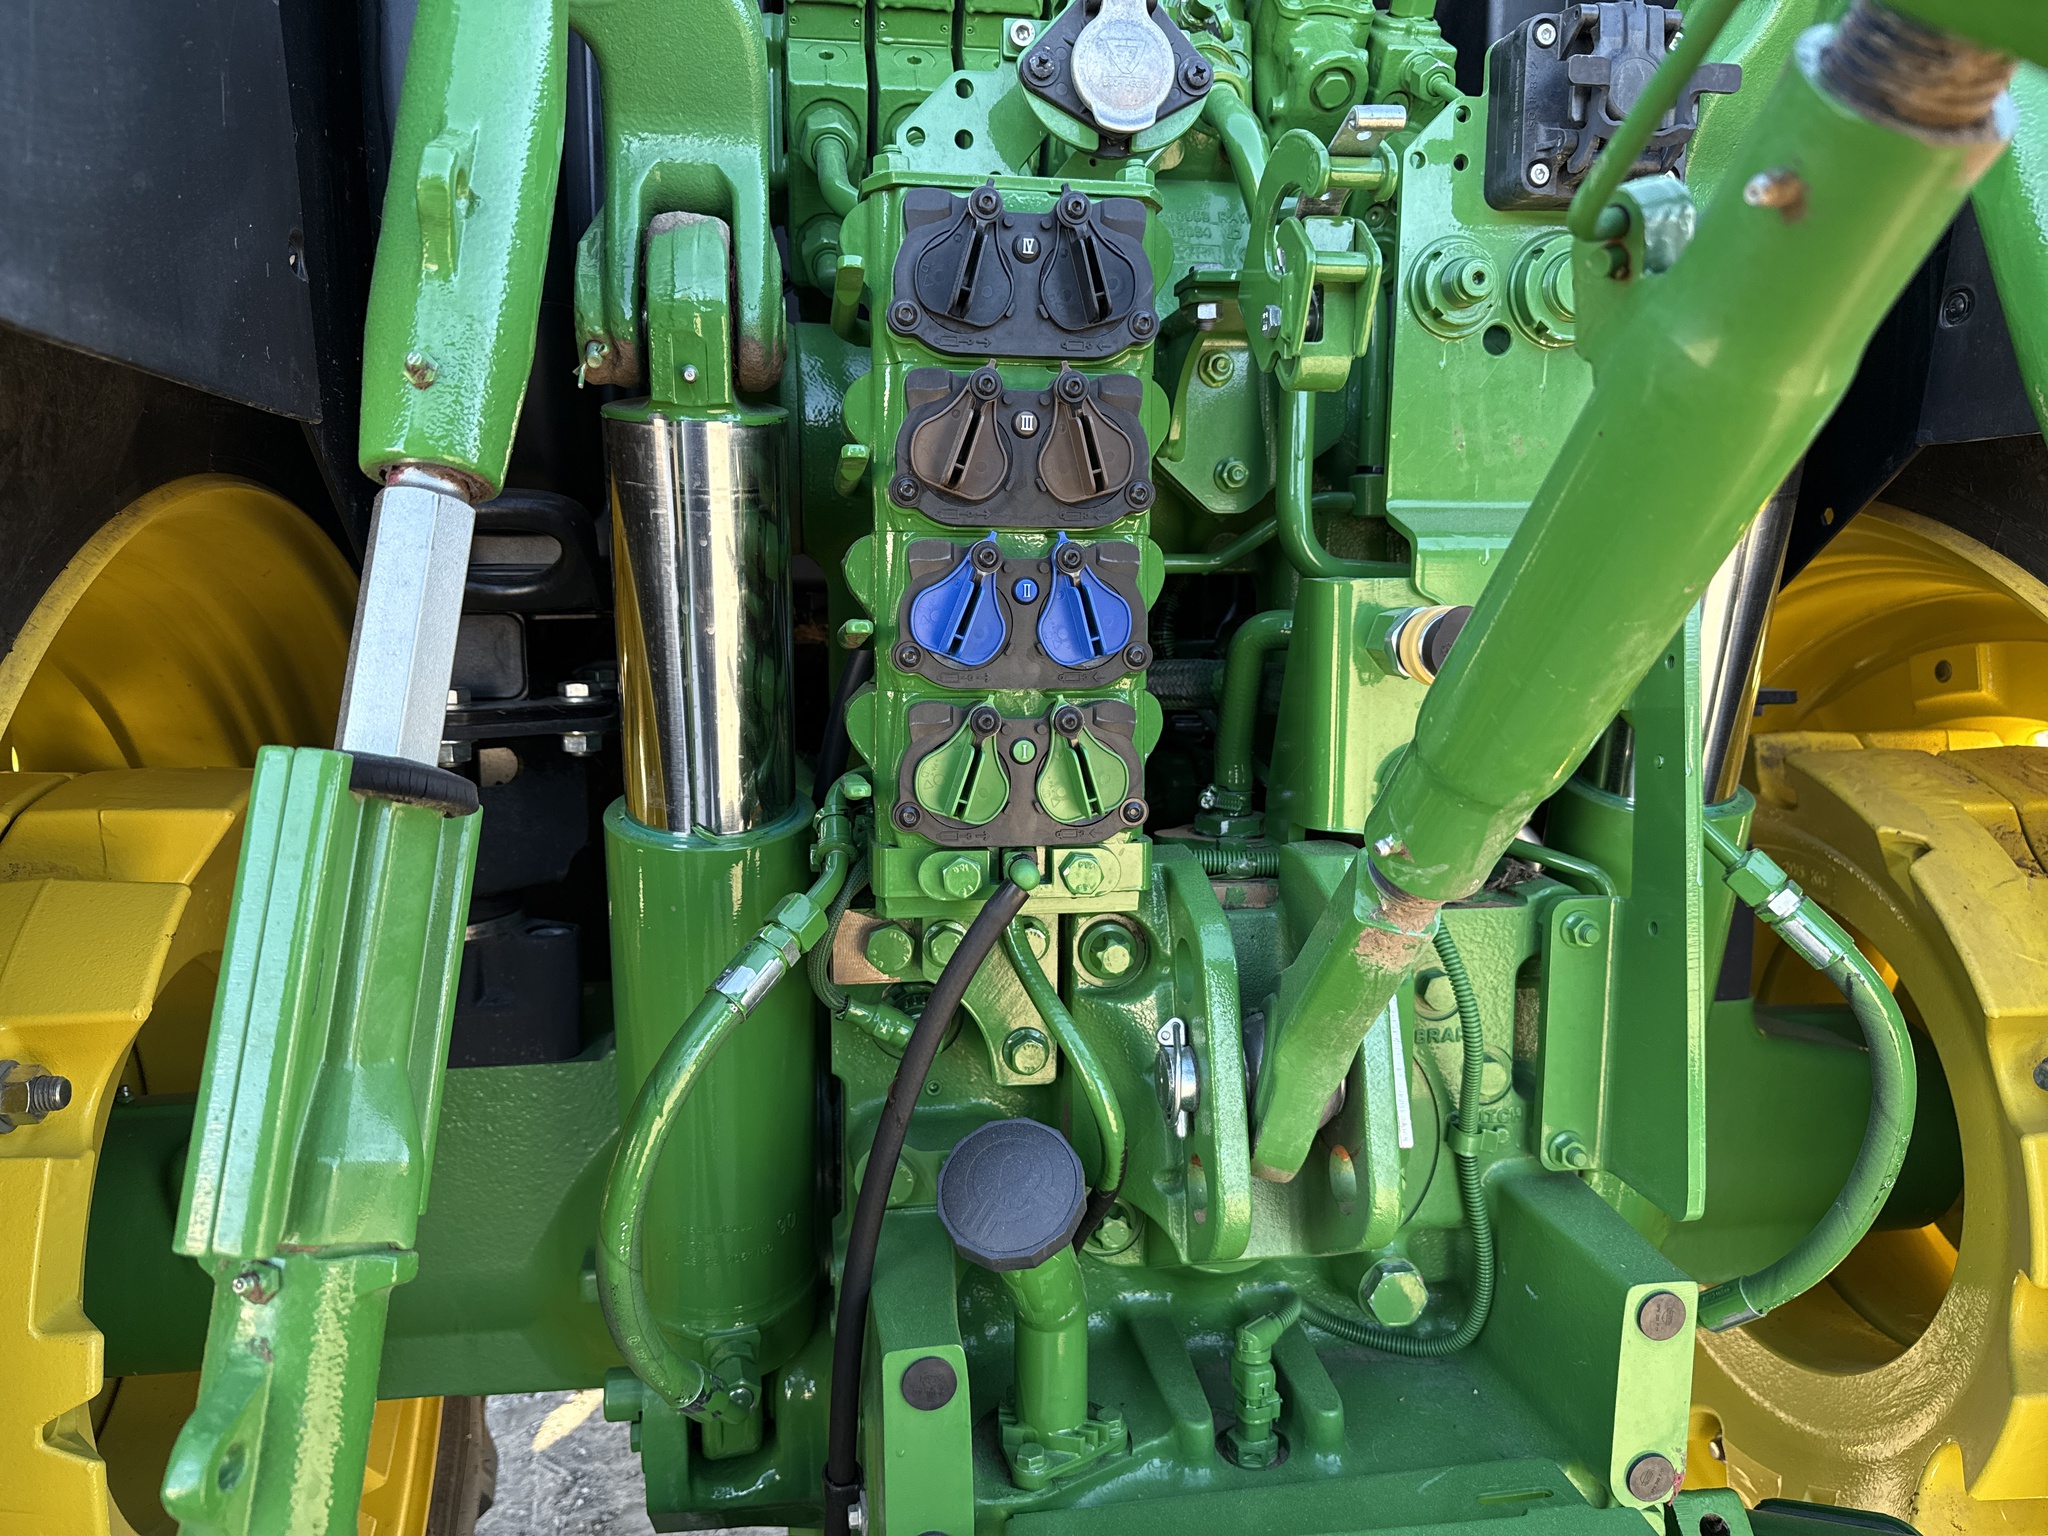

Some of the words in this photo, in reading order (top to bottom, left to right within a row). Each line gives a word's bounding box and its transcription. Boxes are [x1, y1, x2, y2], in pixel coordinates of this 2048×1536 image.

[1022, 237, 1035, 254] IV
[1020, 415, 1034, 431] III
[1022, 583, 1031, 598] II
[1022, 744, 1028, 759] I
